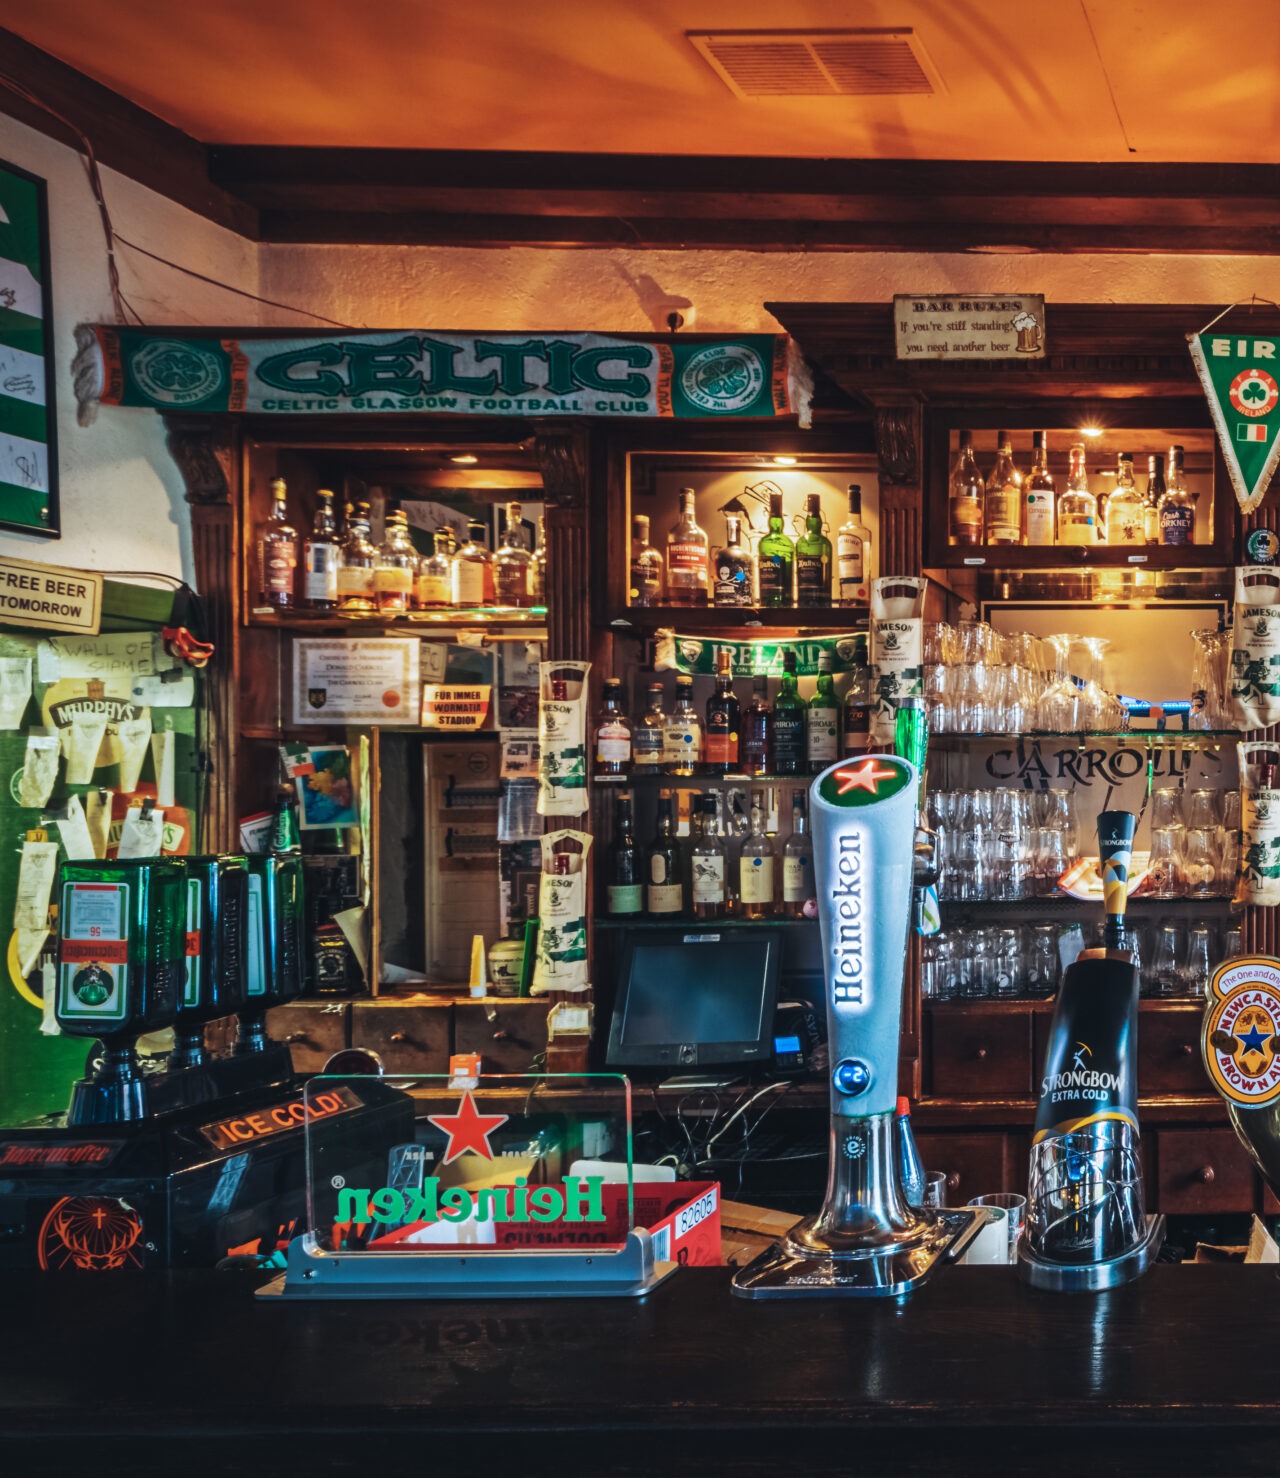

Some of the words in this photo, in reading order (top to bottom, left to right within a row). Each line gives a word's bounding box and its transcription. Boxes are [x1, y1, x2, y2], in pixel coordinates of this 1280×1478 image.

[912, 301, 953, 312] BAR
[958, 301, 1023, 312] RULES
[946, 320, 967, 331] still
[906, 343, 923, 354] you
[927, 341, 948, 352] need
[953, 340, 987, 352] another
[991, 341, 1011, 351] beer
[255, 335, 653, 398] CELTIC
[262, 398, 339, 411] CELTIC
[351, 396, 457, 410] GLASGOW
[468, 399, 583, 411] FOOTBALL
[594, 399, 649, 413] CLUB
[1237, 404, 1272, 417] IRELAND
[1159, 520, 1192, 529] ORKNEY
[45, 580, 87, 599] BEER
[65, 642, 114, 656] WALL
[453, 691, 482, 700] IMMER
[438, 716, 477, 725] STADION
[831, 831, 864, 1006] Heineken
[1222, 974, 1237, 989] The
[1237, 969, 1253, 980] One
[1254, 969, 1268, 979] and
[1220, 1056, 1269, 1092] BROWN
[1040, 1069, 1126, 1099] STRONGBOW
[1051, 1090, 1080, 1104] EXTRA
[1082, 1089, 1109, 1101] COLD
[219, 1115, 272, 1142] ICE
[271, 1091, 348, 1127] COLD!
[680, 1192, 714, 1234] 82605
